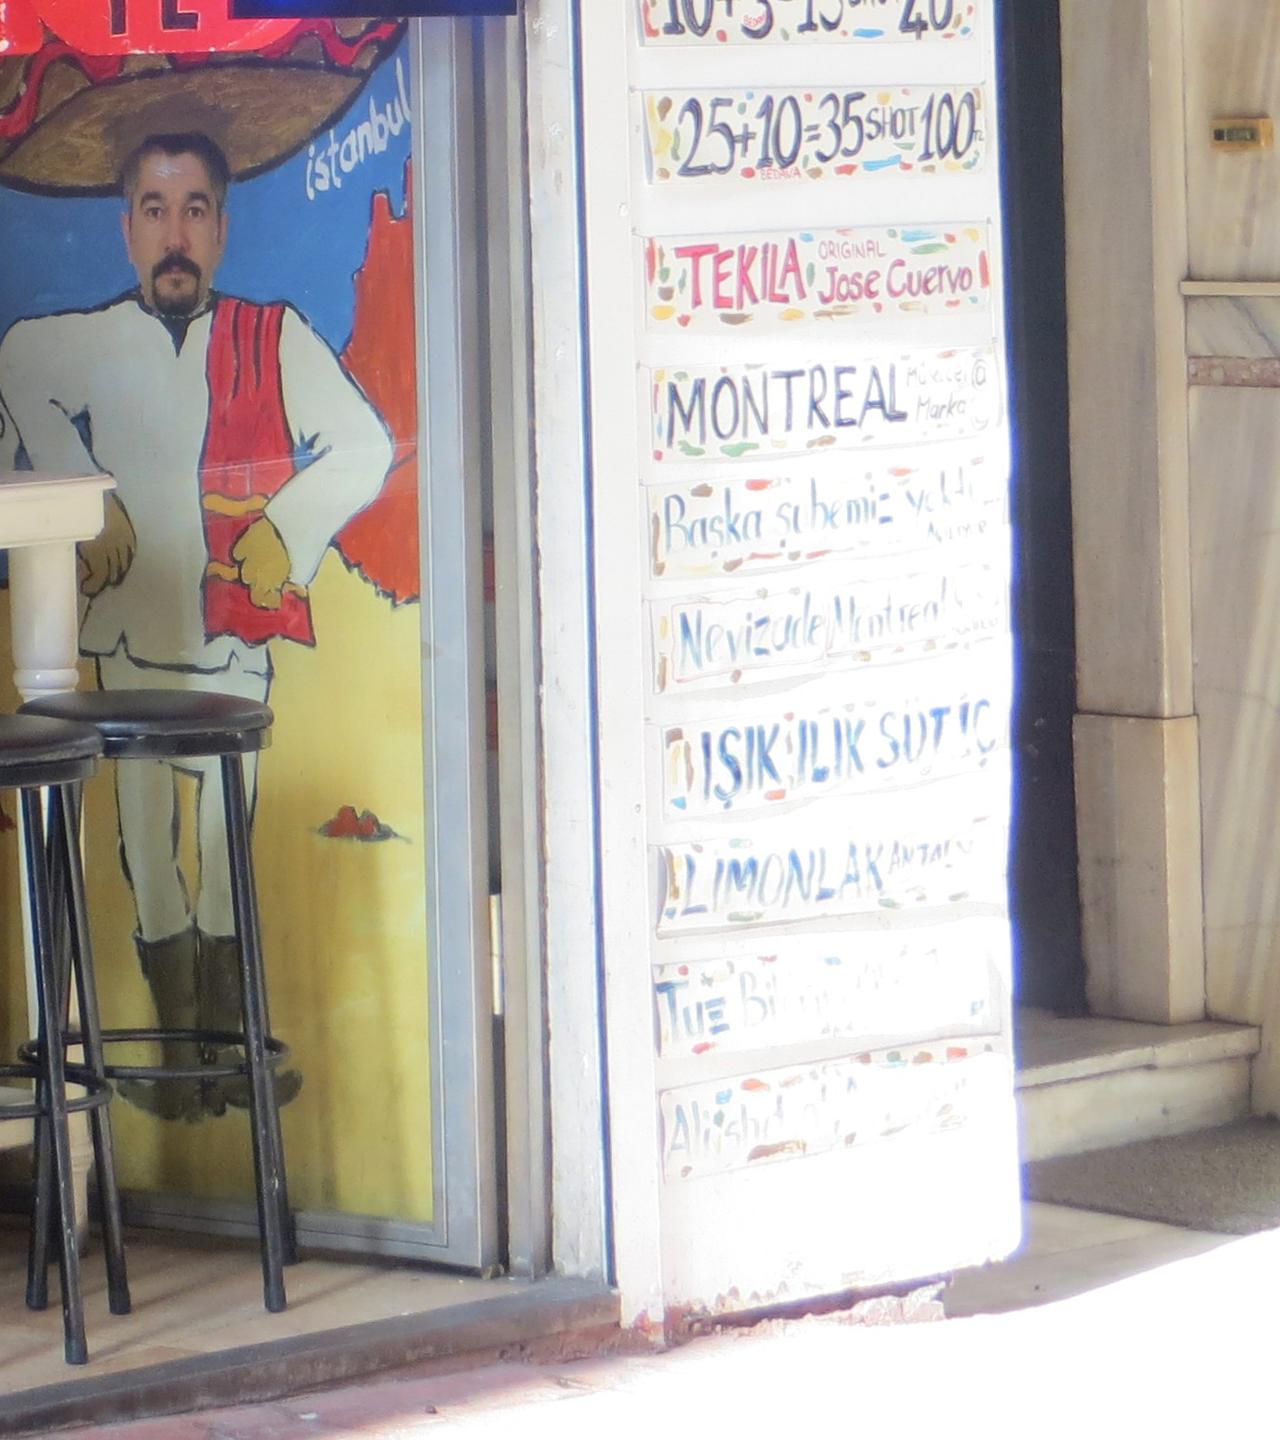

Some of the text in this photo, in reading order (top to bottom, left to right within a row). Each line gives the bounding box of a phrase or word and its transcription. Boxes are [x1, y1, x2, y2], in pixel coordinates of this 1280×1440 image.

[864, 105, 920, 142] SHOT
[916, 90, 977, 162] 100
[817, 239, 887, 260] ORIGINAL
[817, 257, 973, 305] Jose Cuervo
[666, 362, 908, 449] MONTREAL
